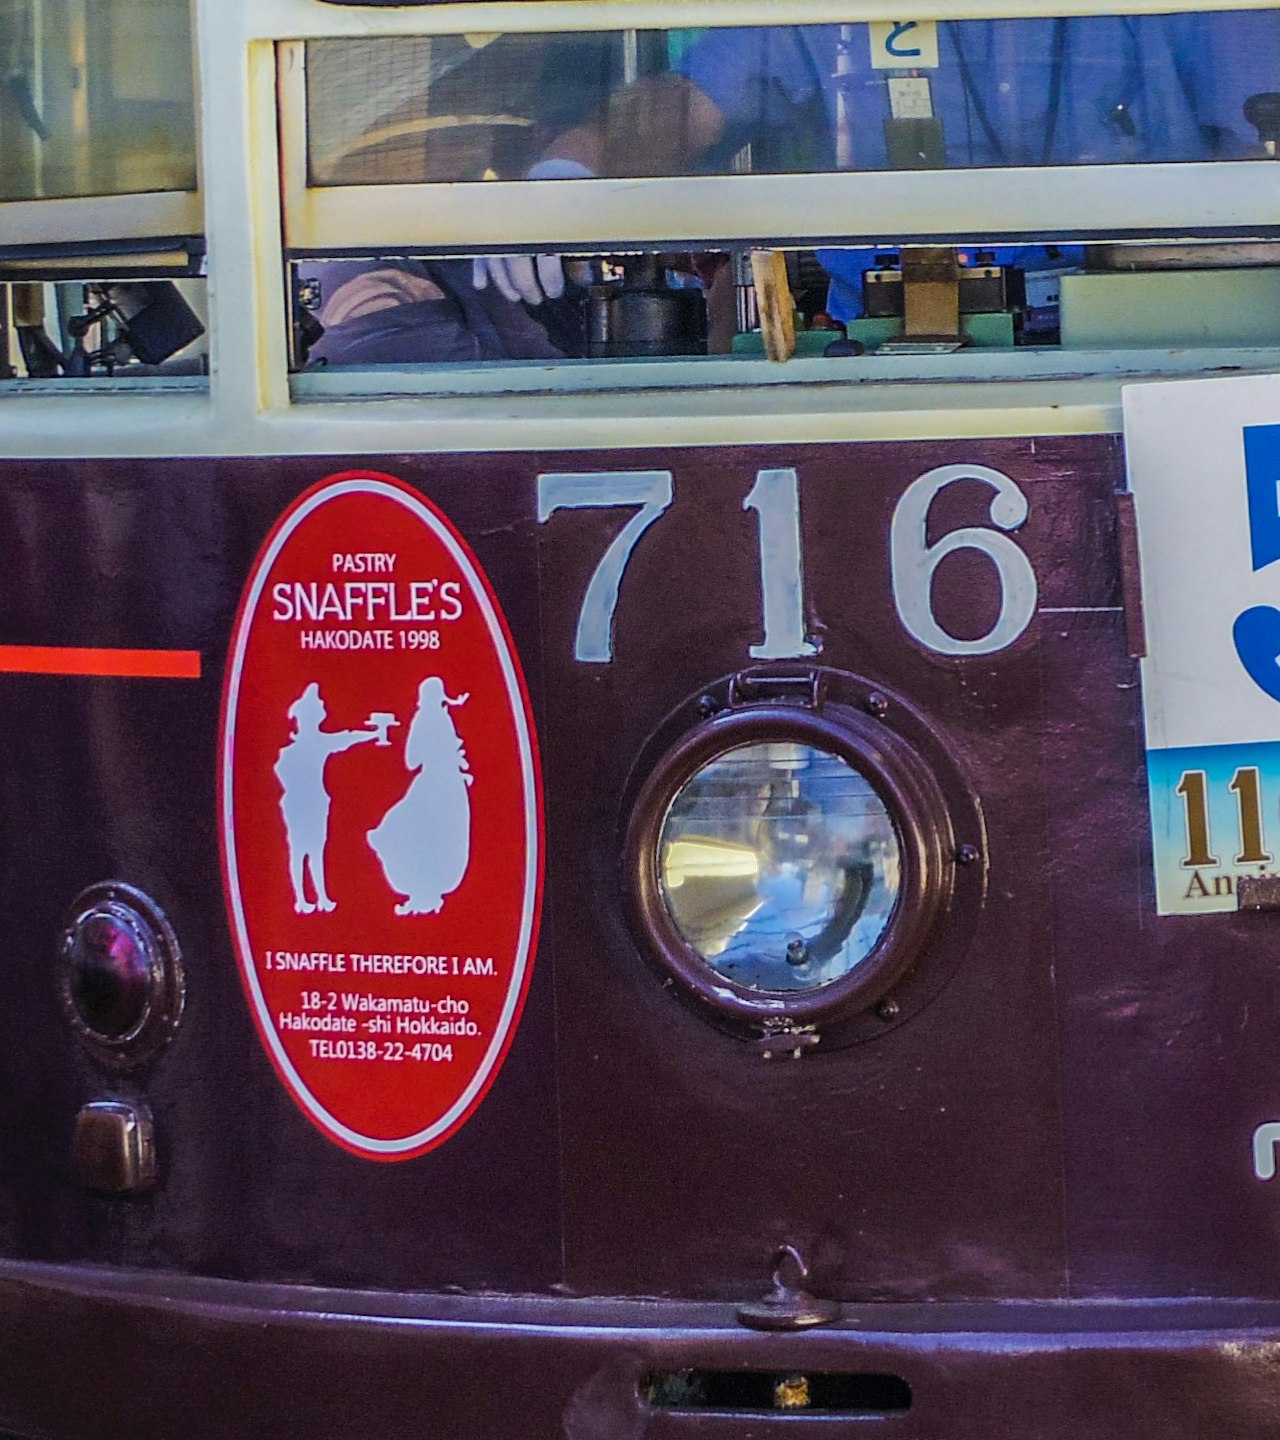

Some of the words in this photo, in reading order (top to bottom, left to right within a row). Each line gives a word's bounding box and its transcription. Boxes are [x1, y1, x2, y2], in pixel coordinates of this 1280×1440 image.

[332, 552, 397, 573] PASTRY
[536, 462, 1039, 663] 716
[272, 578, 463, 621] SNAFFLE'S
[300, 630, 395, 650] HAKODATE
[399, 630, 440, 650] 1998
[265, 951, 272, 970] I
[276, 951, 346, 973] SNAFFLE
[350, 954, 448, 975] THEREFORE
[452, 956, 459, 975] I
[463, 957, 498, 976] AM.
[300, 991, 338, 1010] 18-2
[341, 993, 470, 1015] Wakamatu-cho
[279, 1012, 357, 1033] Hakodate
[396, 1016, 482, 1036] Hokkaido.
[309, 1039, 454, 1062] TEL0138-22-4704
